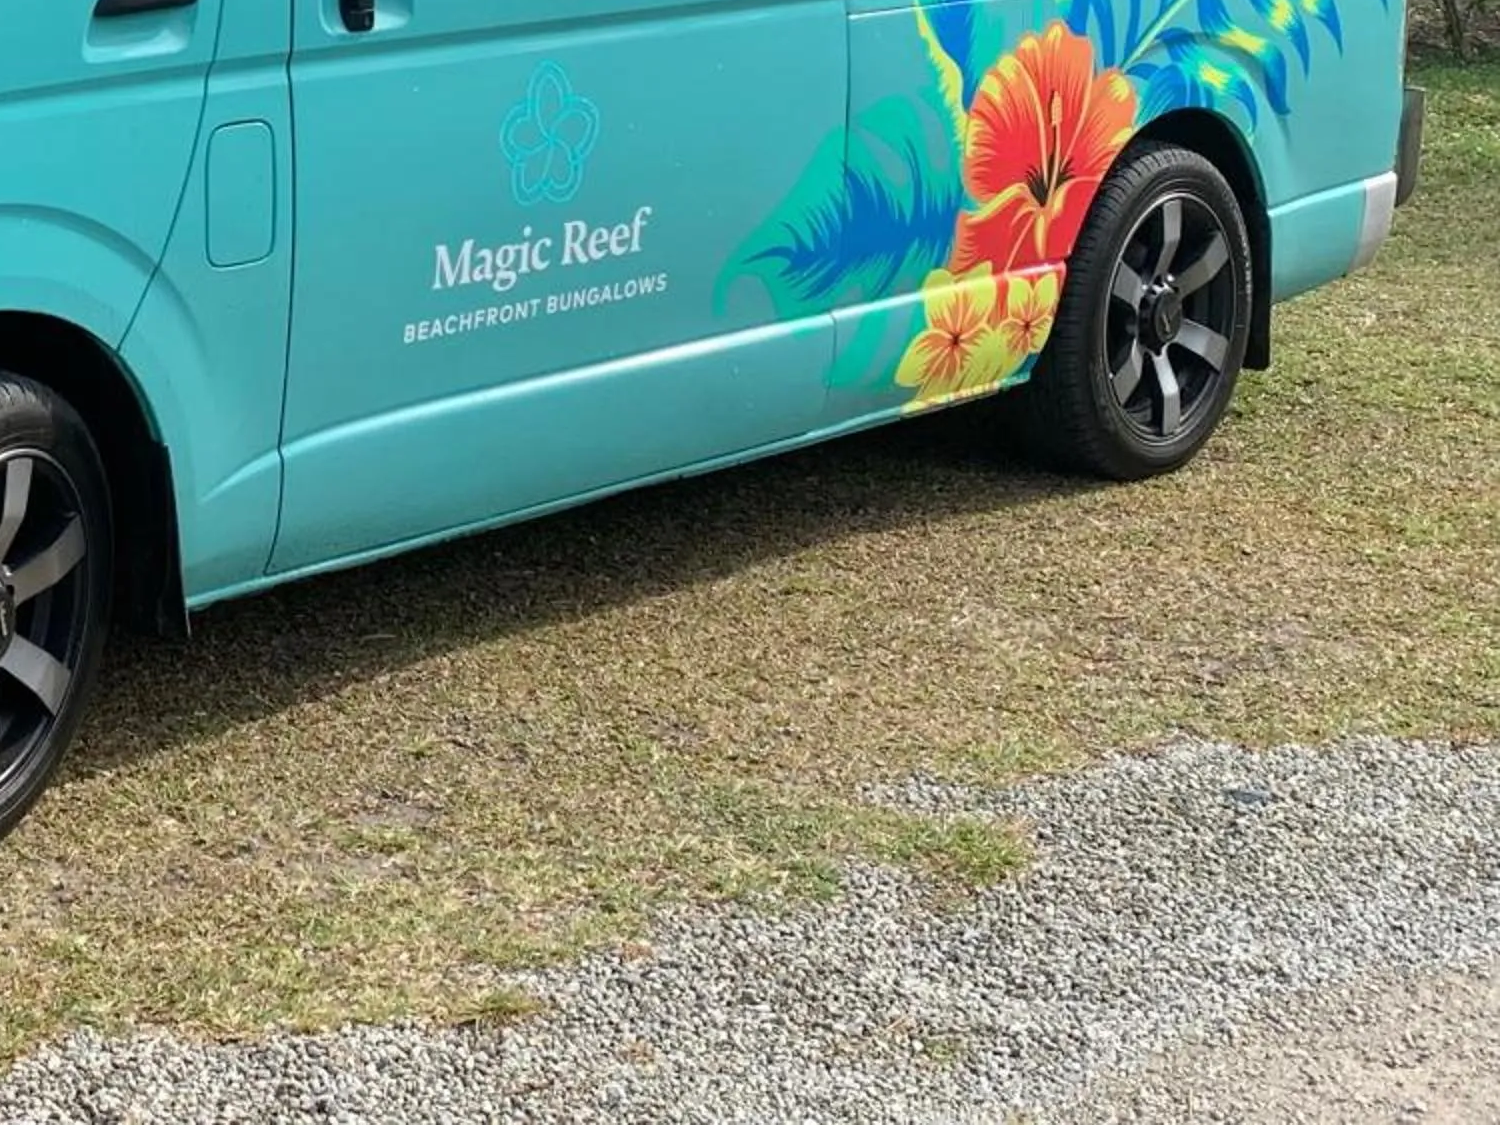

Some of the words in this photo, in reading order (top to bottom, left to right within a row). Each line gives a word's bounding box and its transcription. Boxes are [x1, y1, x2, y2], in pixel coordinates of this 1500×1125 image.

[432, 225, 552, 292] Magic
[560, 206, 652, 266] Reef
[403, 298, 541, 344] BEACHFRONT
[546, 273, 668, 314] BUNGALOWS
